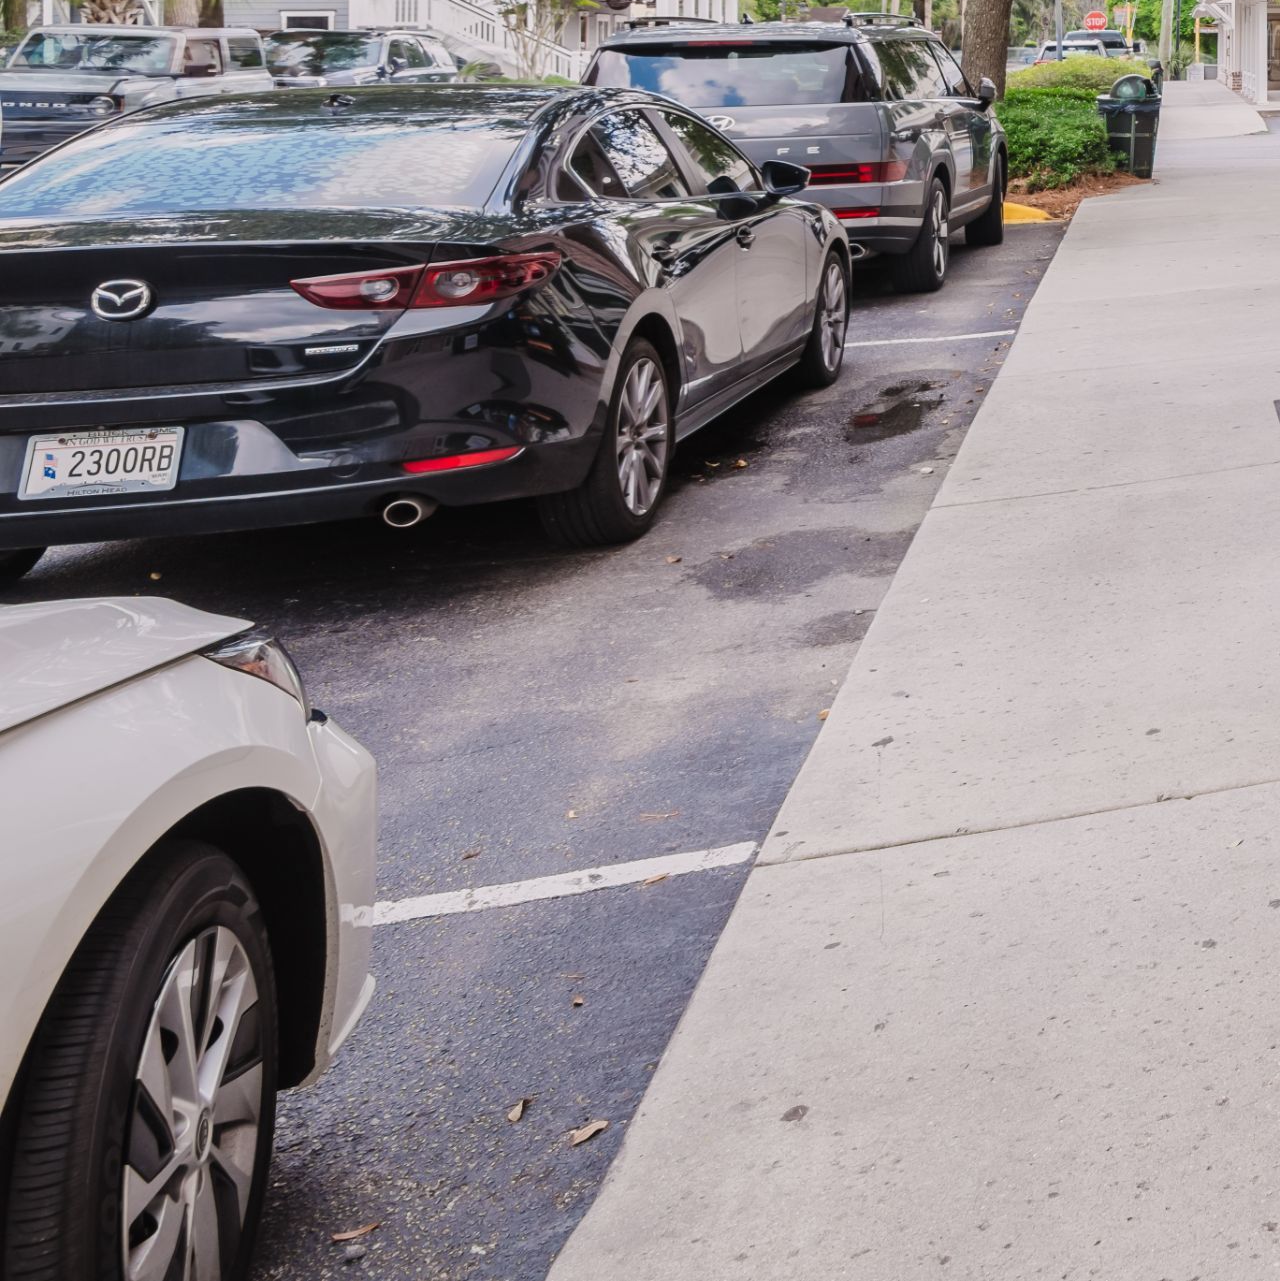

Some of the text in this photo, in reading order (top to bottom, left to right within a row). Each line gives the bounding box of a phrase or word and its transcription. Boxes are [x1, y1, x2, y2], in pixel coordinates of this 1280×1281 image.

[1086, 17, 1106, 26] STOP
[67, 444, 175, 478] 2300RB
[66, 486, 128, 497] HILTON HEAD
